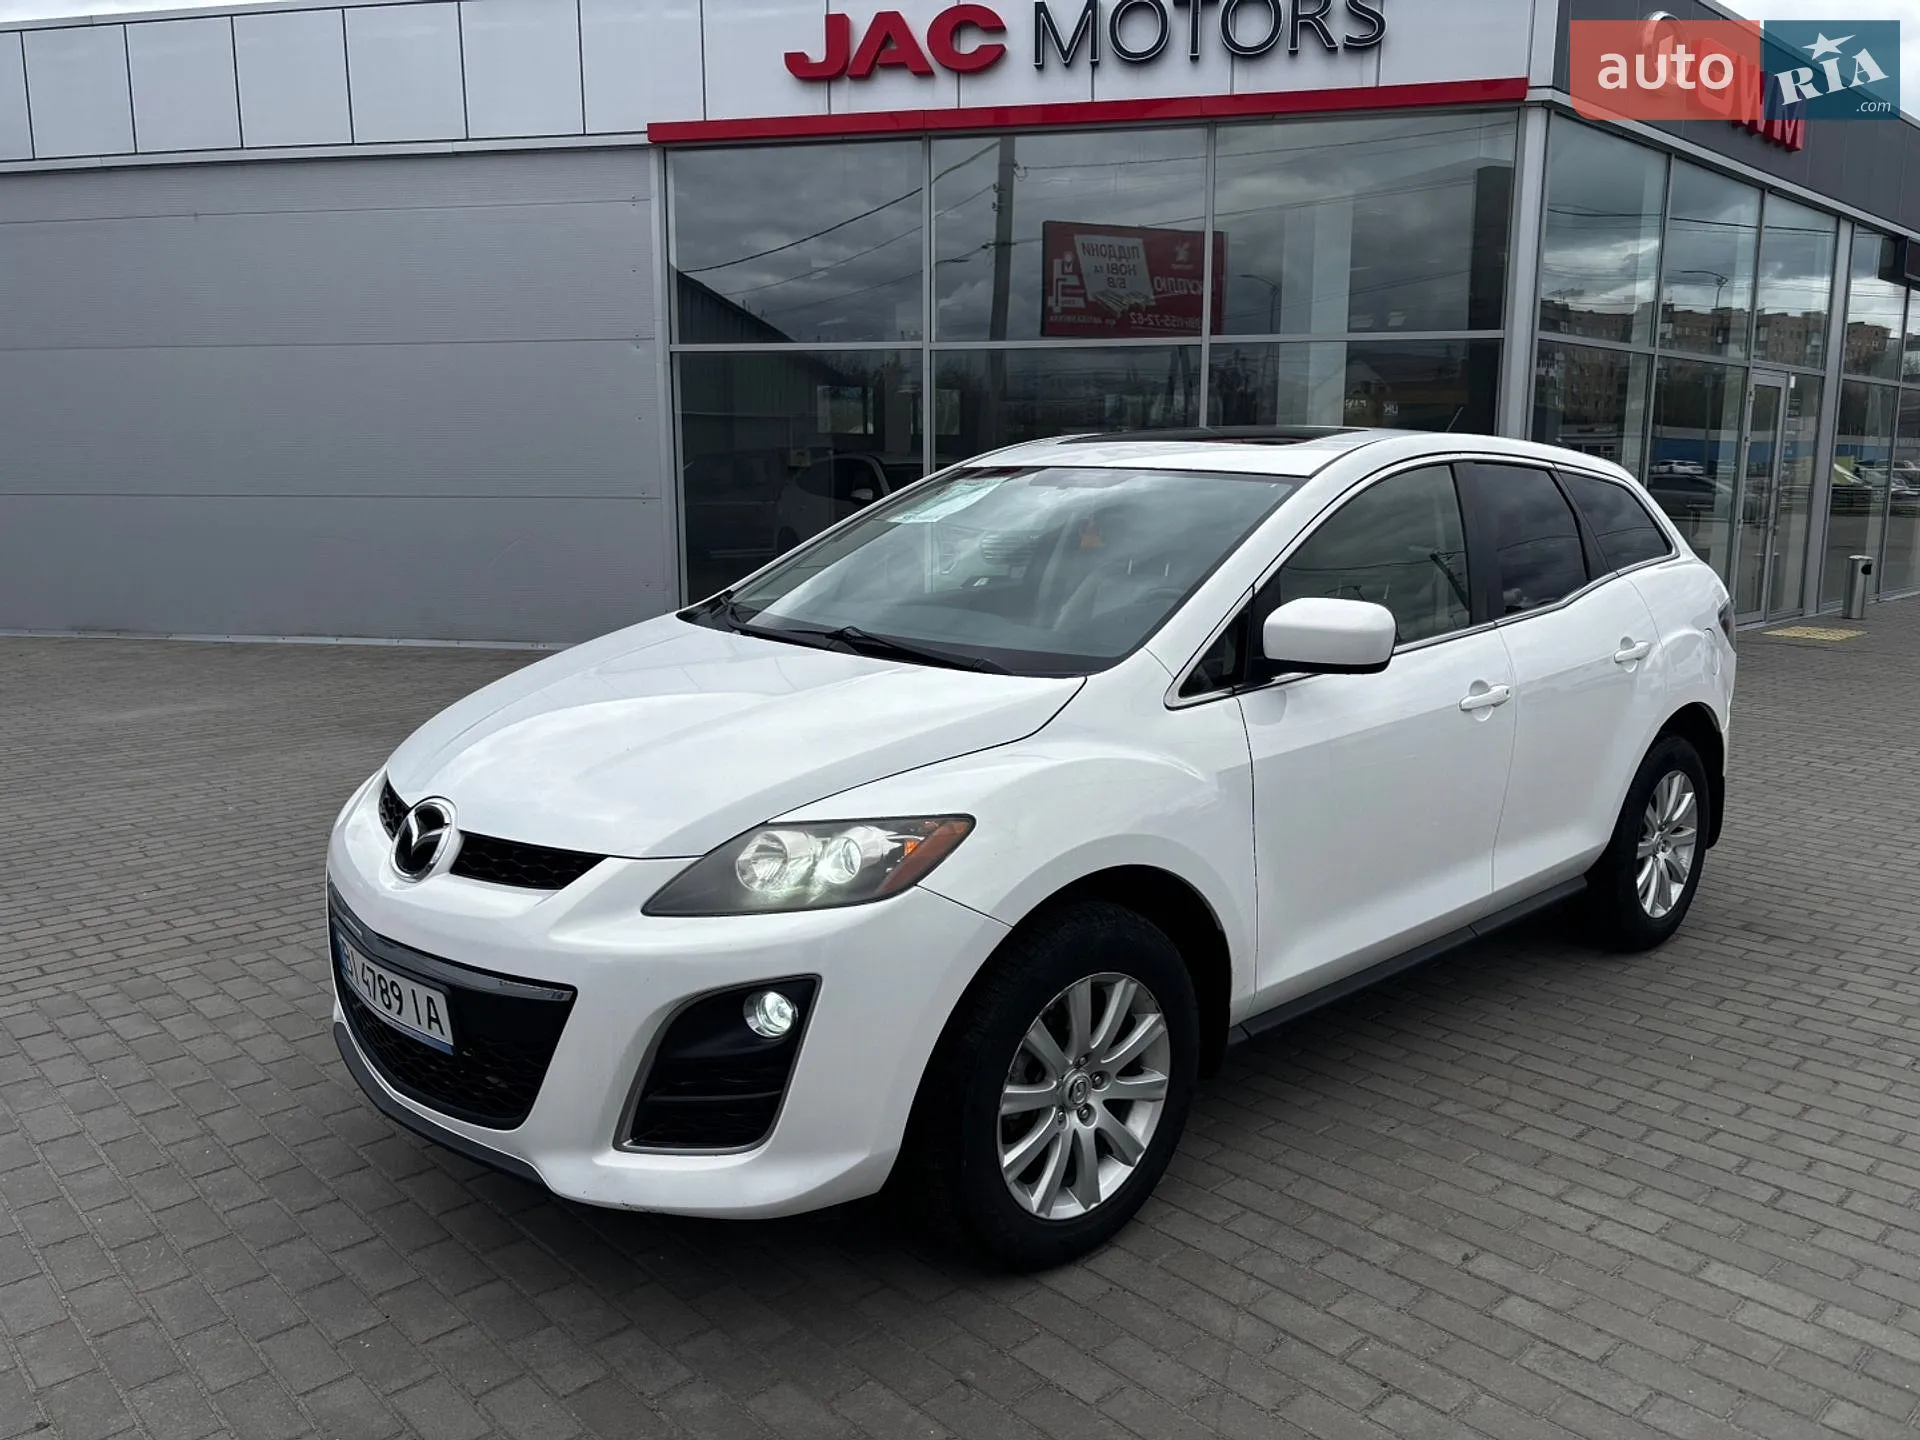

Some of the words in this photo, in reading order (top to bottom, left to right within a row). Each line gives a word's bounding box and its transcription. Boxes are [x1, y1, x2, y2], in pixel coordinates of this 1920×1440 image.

[784, 4, 1007, 80] JAC
[1033, 0, 1388, 70] MOTORS
[361, 962, 404, 1016] 4789
[411, 987, 446, 1037] IA
